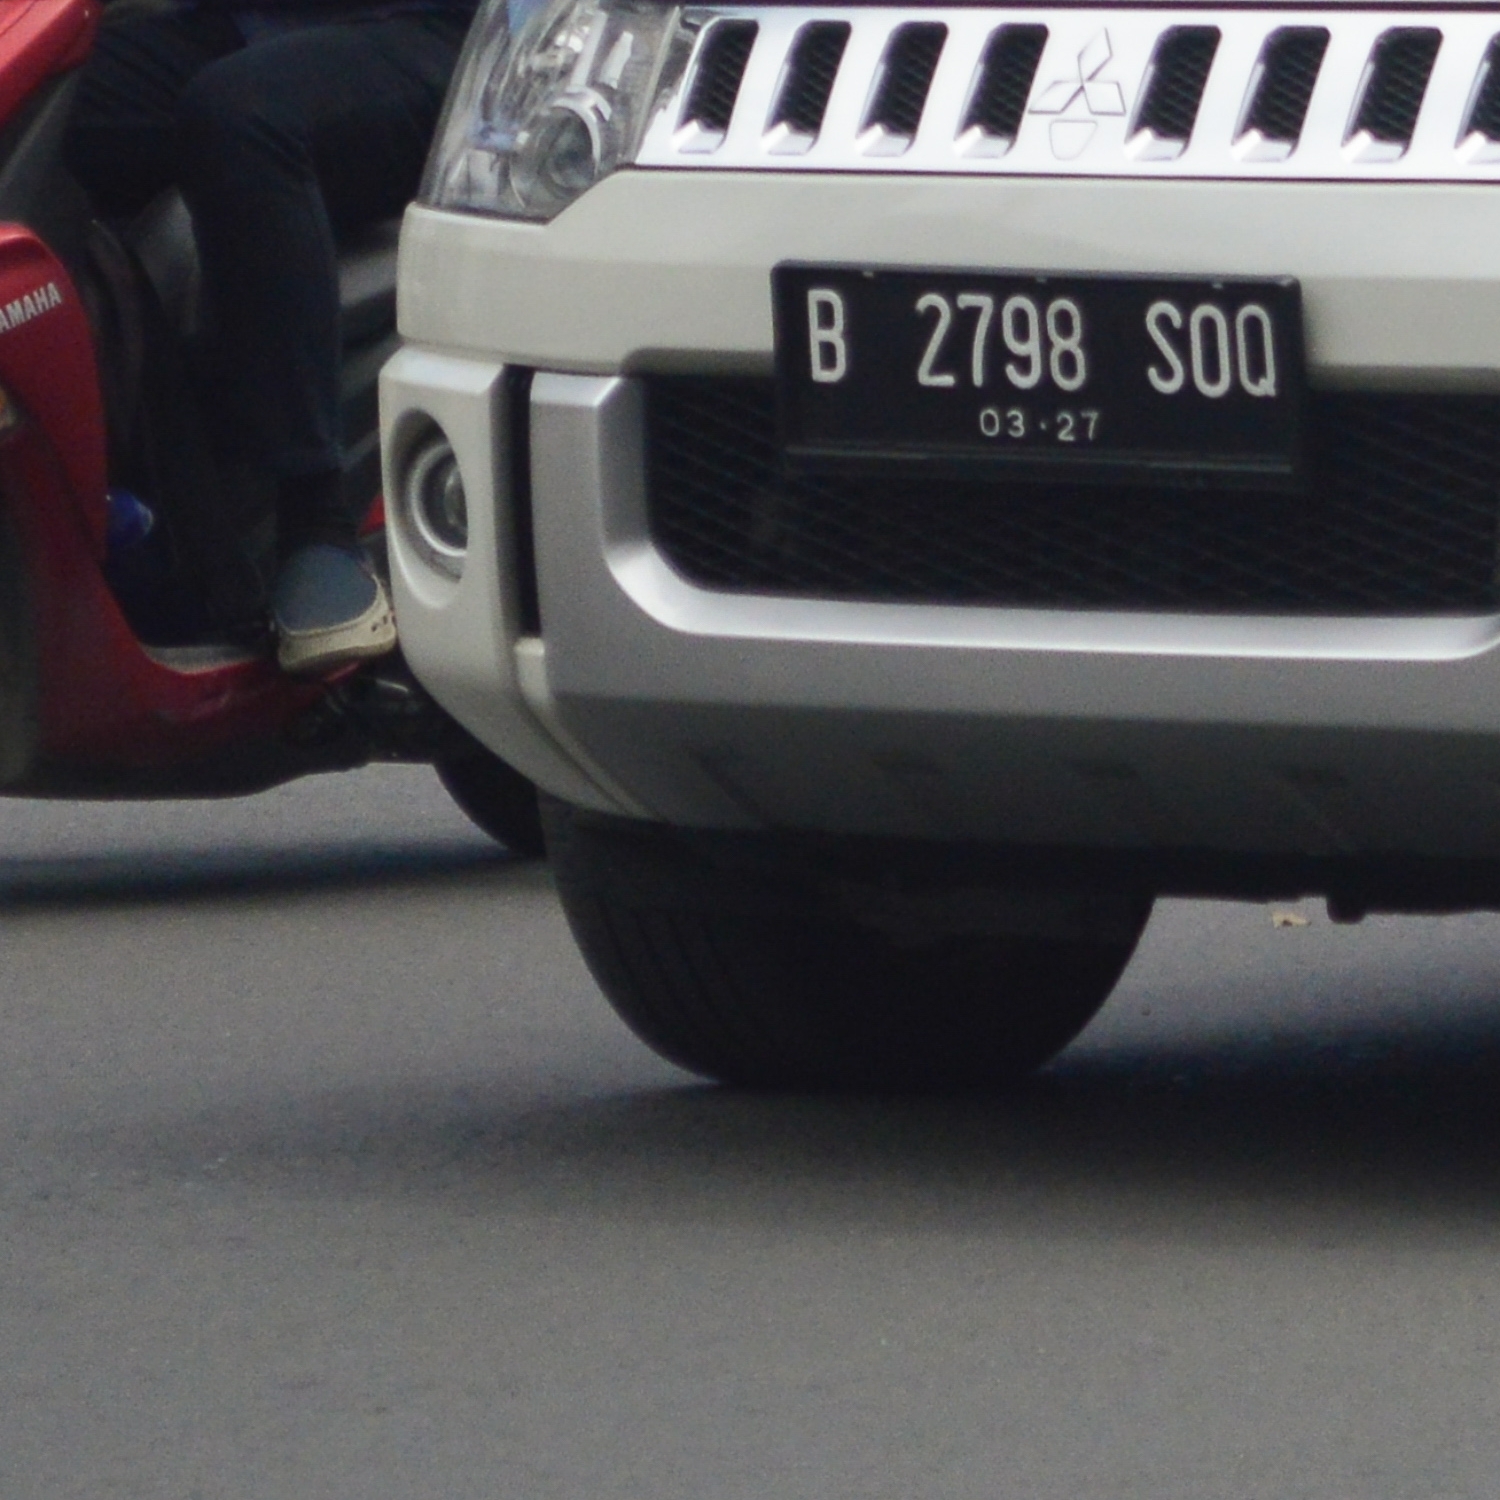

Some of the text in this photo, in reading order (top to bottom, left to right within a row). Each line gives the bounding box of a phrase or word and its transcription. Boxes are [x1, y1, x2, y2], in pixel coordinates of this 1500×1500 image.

[0, 282, 62, 333] AMAHA
[807, 288, 1277, 399] B 2798 SOQ
